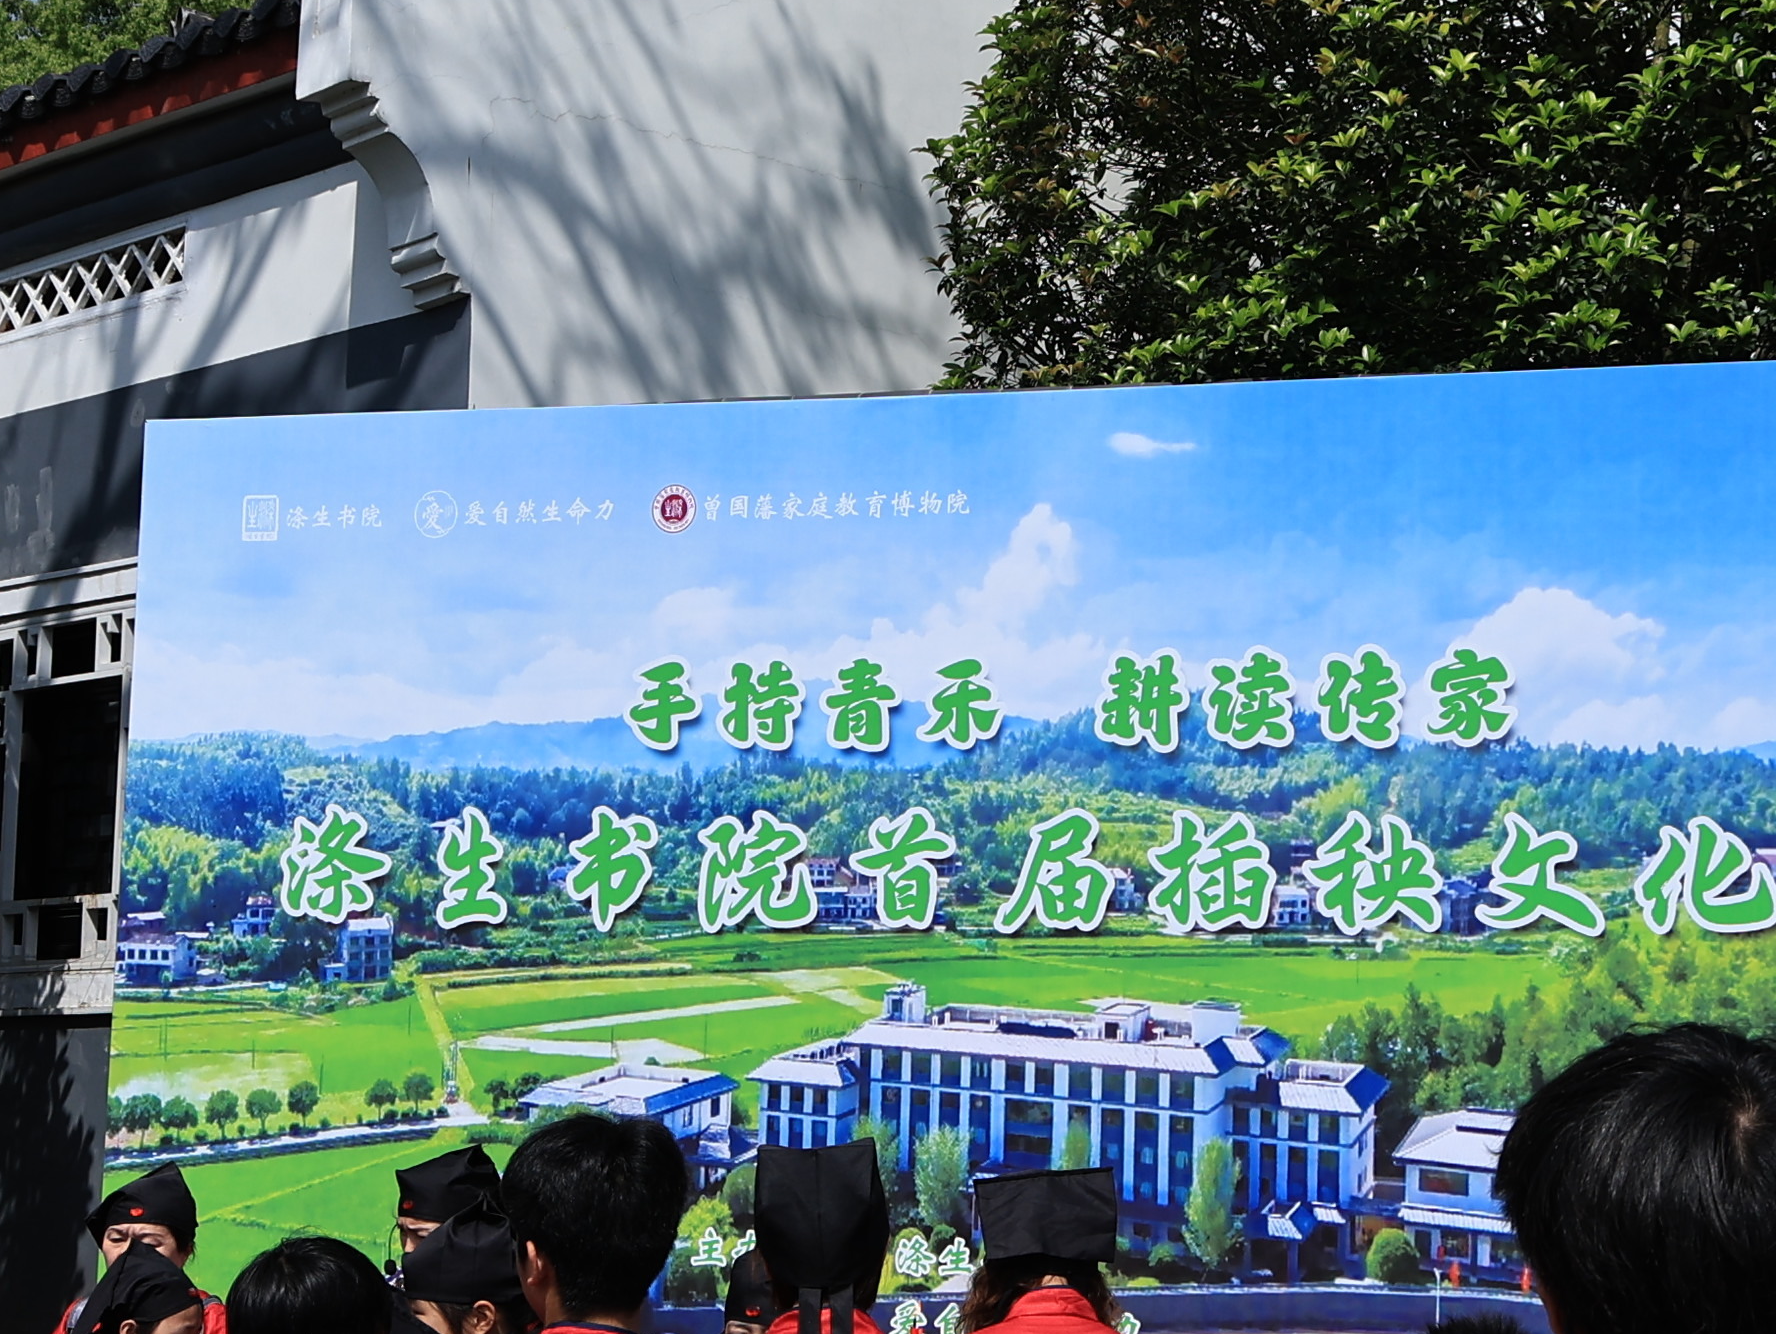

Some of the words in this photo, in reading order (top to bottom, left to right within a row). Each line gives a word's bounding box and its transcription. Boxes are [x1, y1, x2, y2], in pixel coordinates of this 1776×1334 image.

[286, 504, 382, 530] 涤生书院
[464, 497, 614, 527] 爱自然生命力
[703, 489, 970, 521] 曾国藩家庭教育博物院
[1097, 646, 1516, 750] 耕读传家
